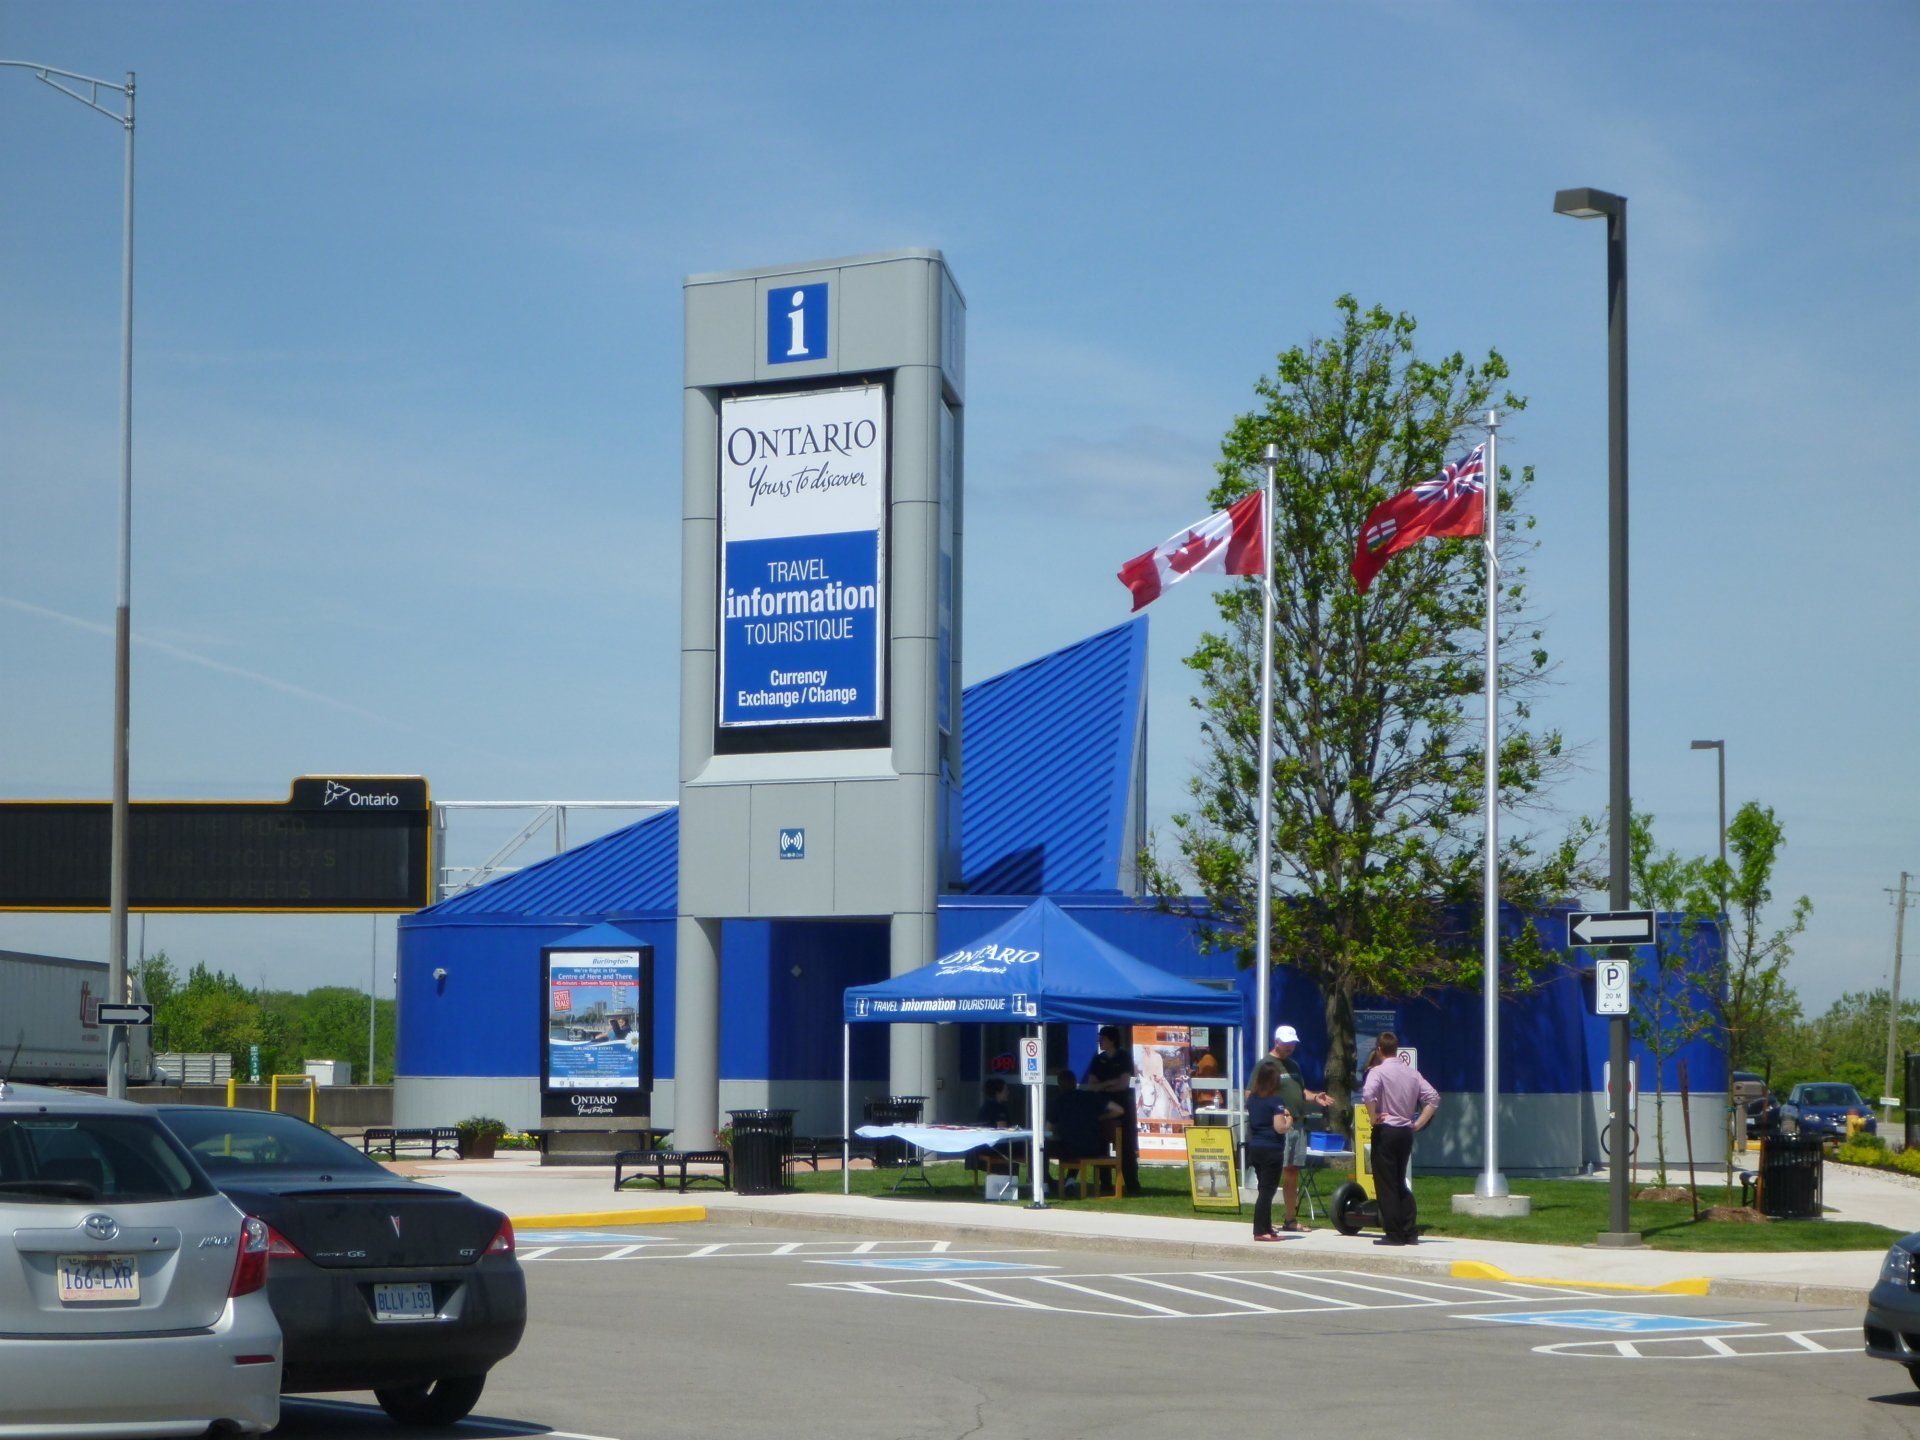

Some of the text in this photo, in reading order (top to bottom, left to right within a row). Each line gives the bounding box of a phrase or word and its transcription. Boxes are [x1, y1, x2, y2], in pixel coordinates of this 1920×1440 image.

[727, 419, 877, 466] ONTARIO
[749, 461, 868, 507] Yours to discover
[767, 558, 829, 583] TRAVEL
[726, 581, 875, 618] information
[744, 617, 854, 645] TOURISTIQUE
[770, 669, 828, 686] Currency
[349, 792, 399, 806] Ontario
[592, 958, 629, 966] Burlington
[938, 943, 1040, 965] ONTARIO
[1607, 968, 1619, 986] P
[873, 1000, 899, 1012] TRAVEL
[901, 998, 957, 1012] information
[958, 998, 1006, 1011] TOURISTIQUE
[571, 1094, 618, 1106] ONTARIO
[347, 1250, 367, 1258] G6
[64, 1266, 134, 1290] 166 LXR
[377, 1290, 432, 1311] BLLV 193
